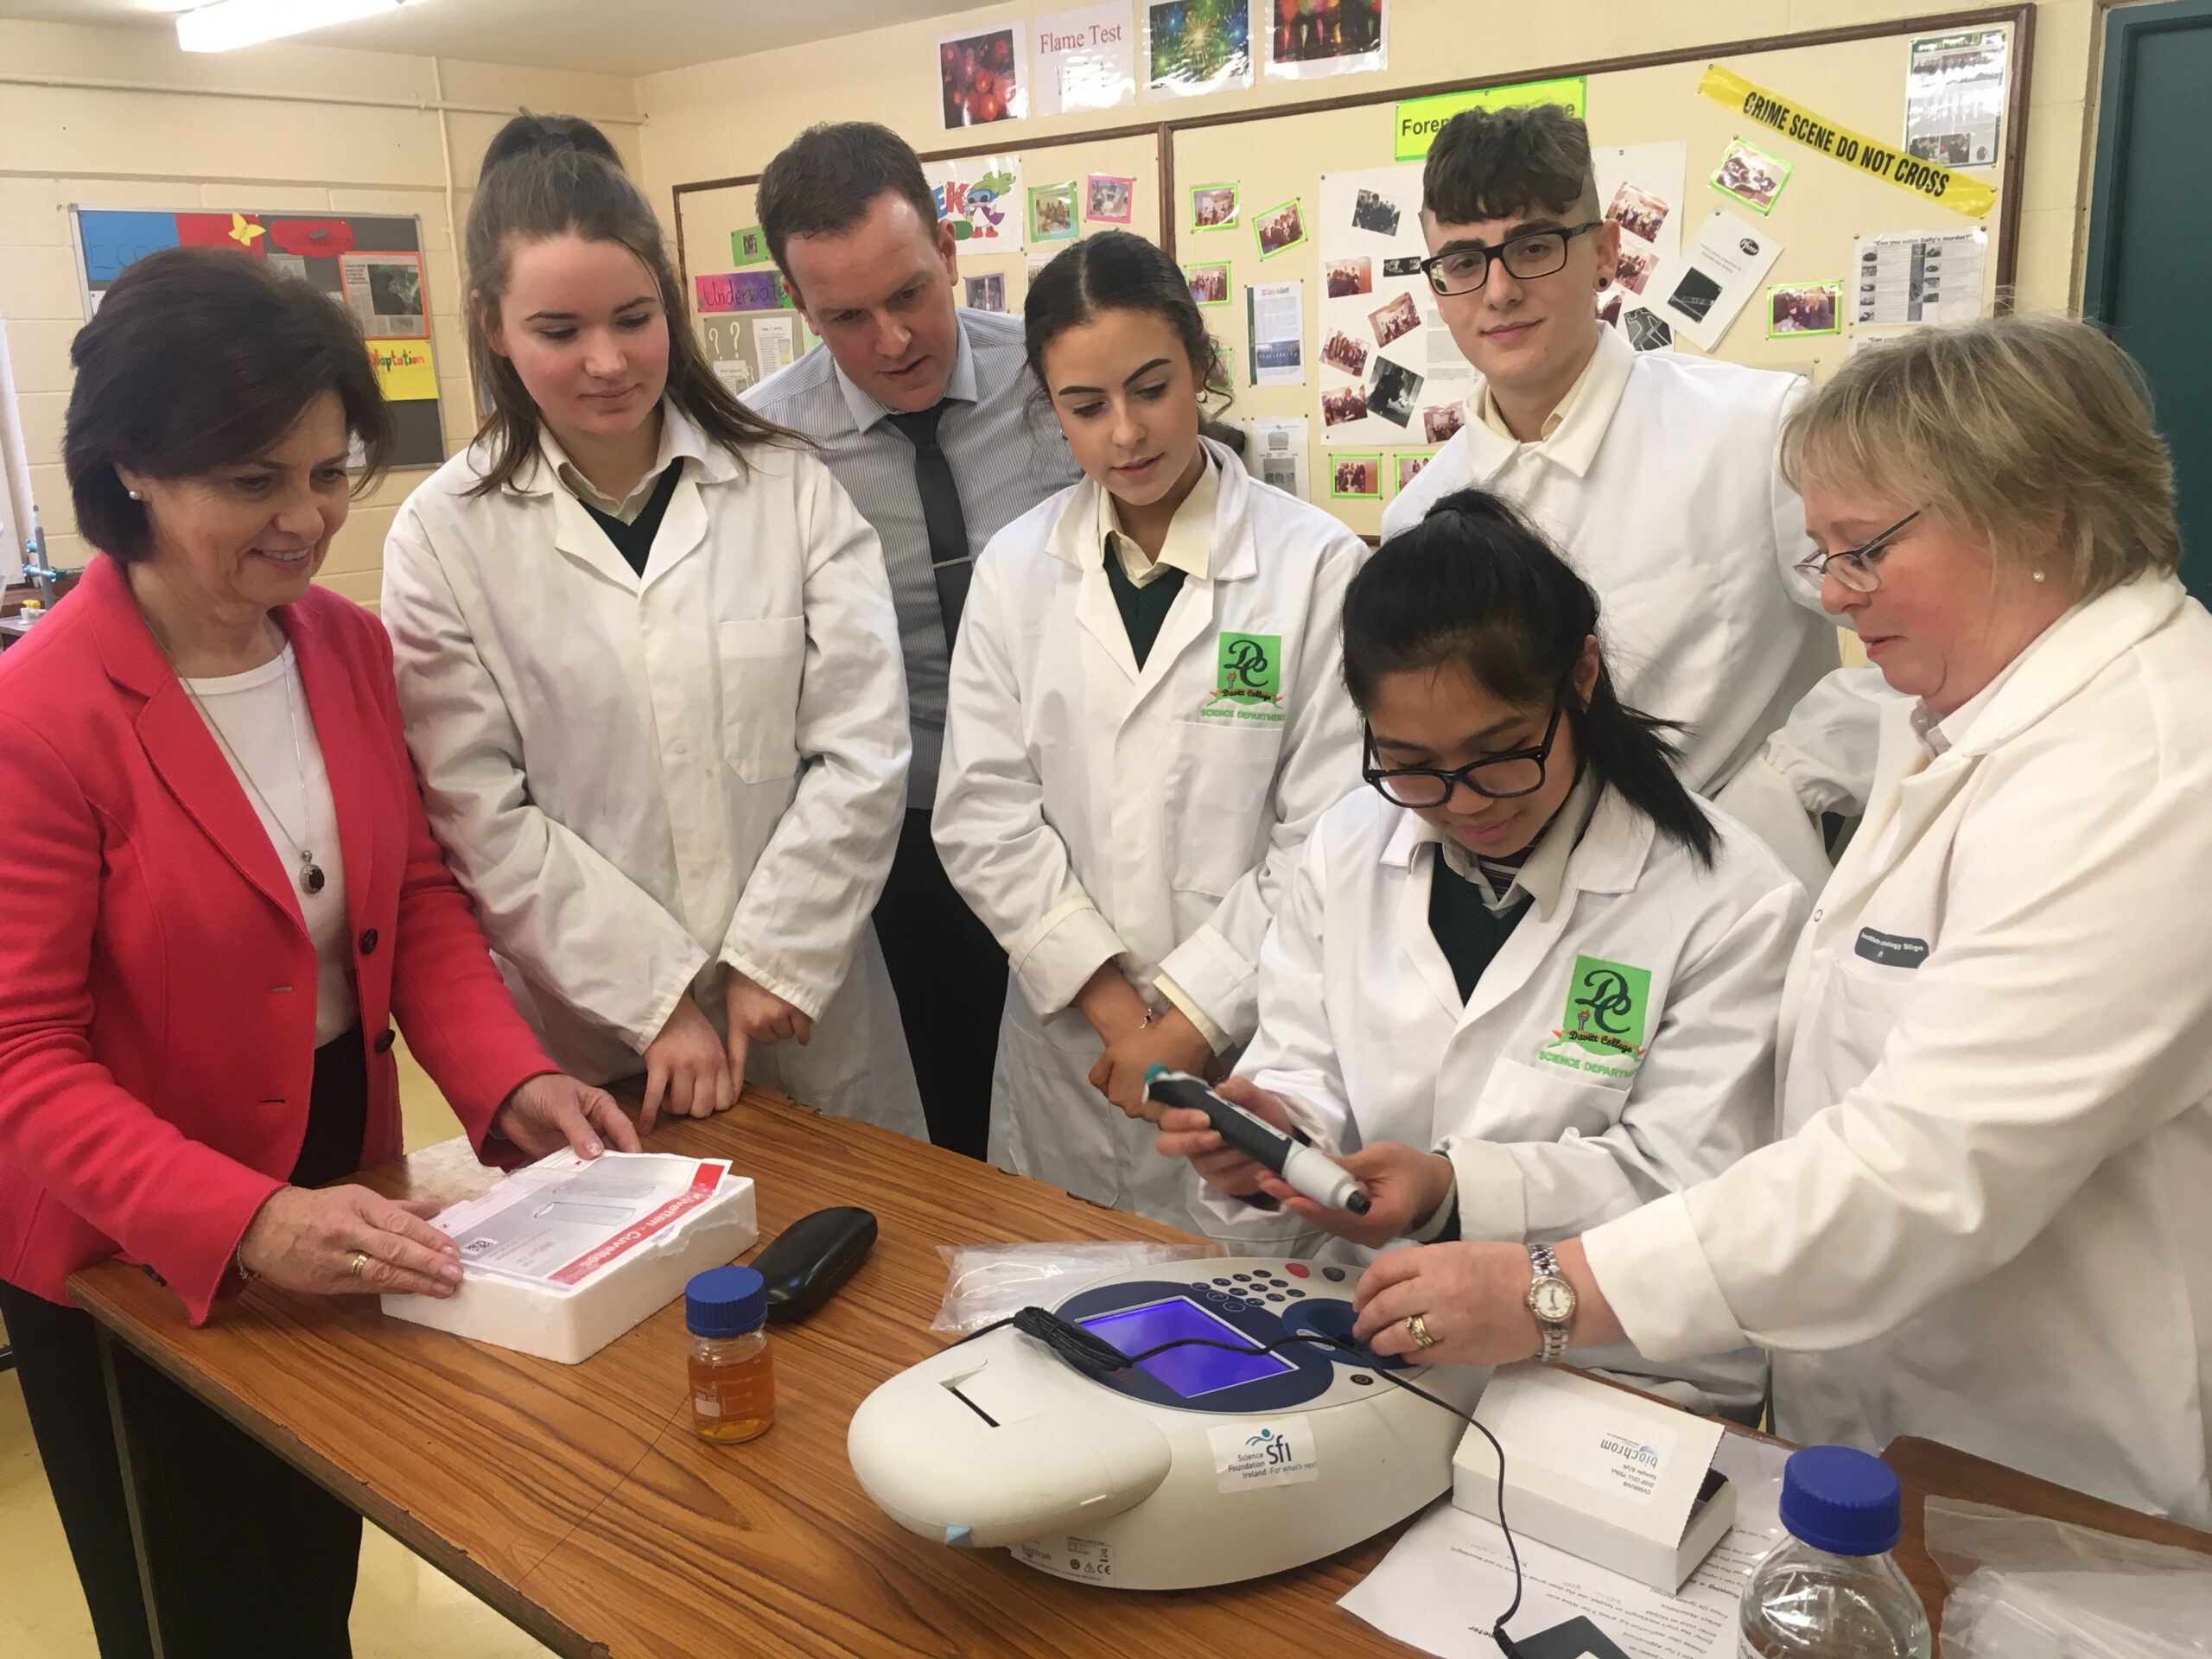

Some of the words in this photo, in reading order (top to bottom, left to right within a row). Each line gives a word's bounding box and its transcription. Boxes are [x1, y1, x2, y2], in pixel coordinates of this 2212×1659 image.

[1039, 32, 1084, 54] Flame
[1089, 23, 1122, 45] Test
[1401, 115, 1451, 137] Foren
[1743, 92, 1790, 131] CRIME
[1789, 114, 1835, 154] SCENE
[1835, 136, 1859, 162] DO
[1859, 145, 1895, 176] NOT
[1894, 158, 1950, 198] CROSS
[931, 181, 969, 219] EK
[702, 272, 789, 307] Underwate
[371, 347, 425, 372] daptation
[1201, 709, 1234, 718] SCIENCE
[1237, 710, 1286, 721] DEPARTMENT
[1903, 943, 1924, 952] Sligo
[1600, 1035, 1632, 1053] College
[1538, 1051, 1580, 1069] SCIENCE
[1584, 1062, 1636, 1078] DEPARTM
[581, 1231, 642, 1267] Cuvettes
[1237, 1452, 1263, 1462] Science
[1600, 1439, 1658, 1469] biochrom
[1228, 1460, 1265, 1472] Foundation
[1243, 1469, 1267, 1478] Ireland
[1708, 1584, 1740, 1599] Running
[1468, 1626, 1495, 1639] meter
